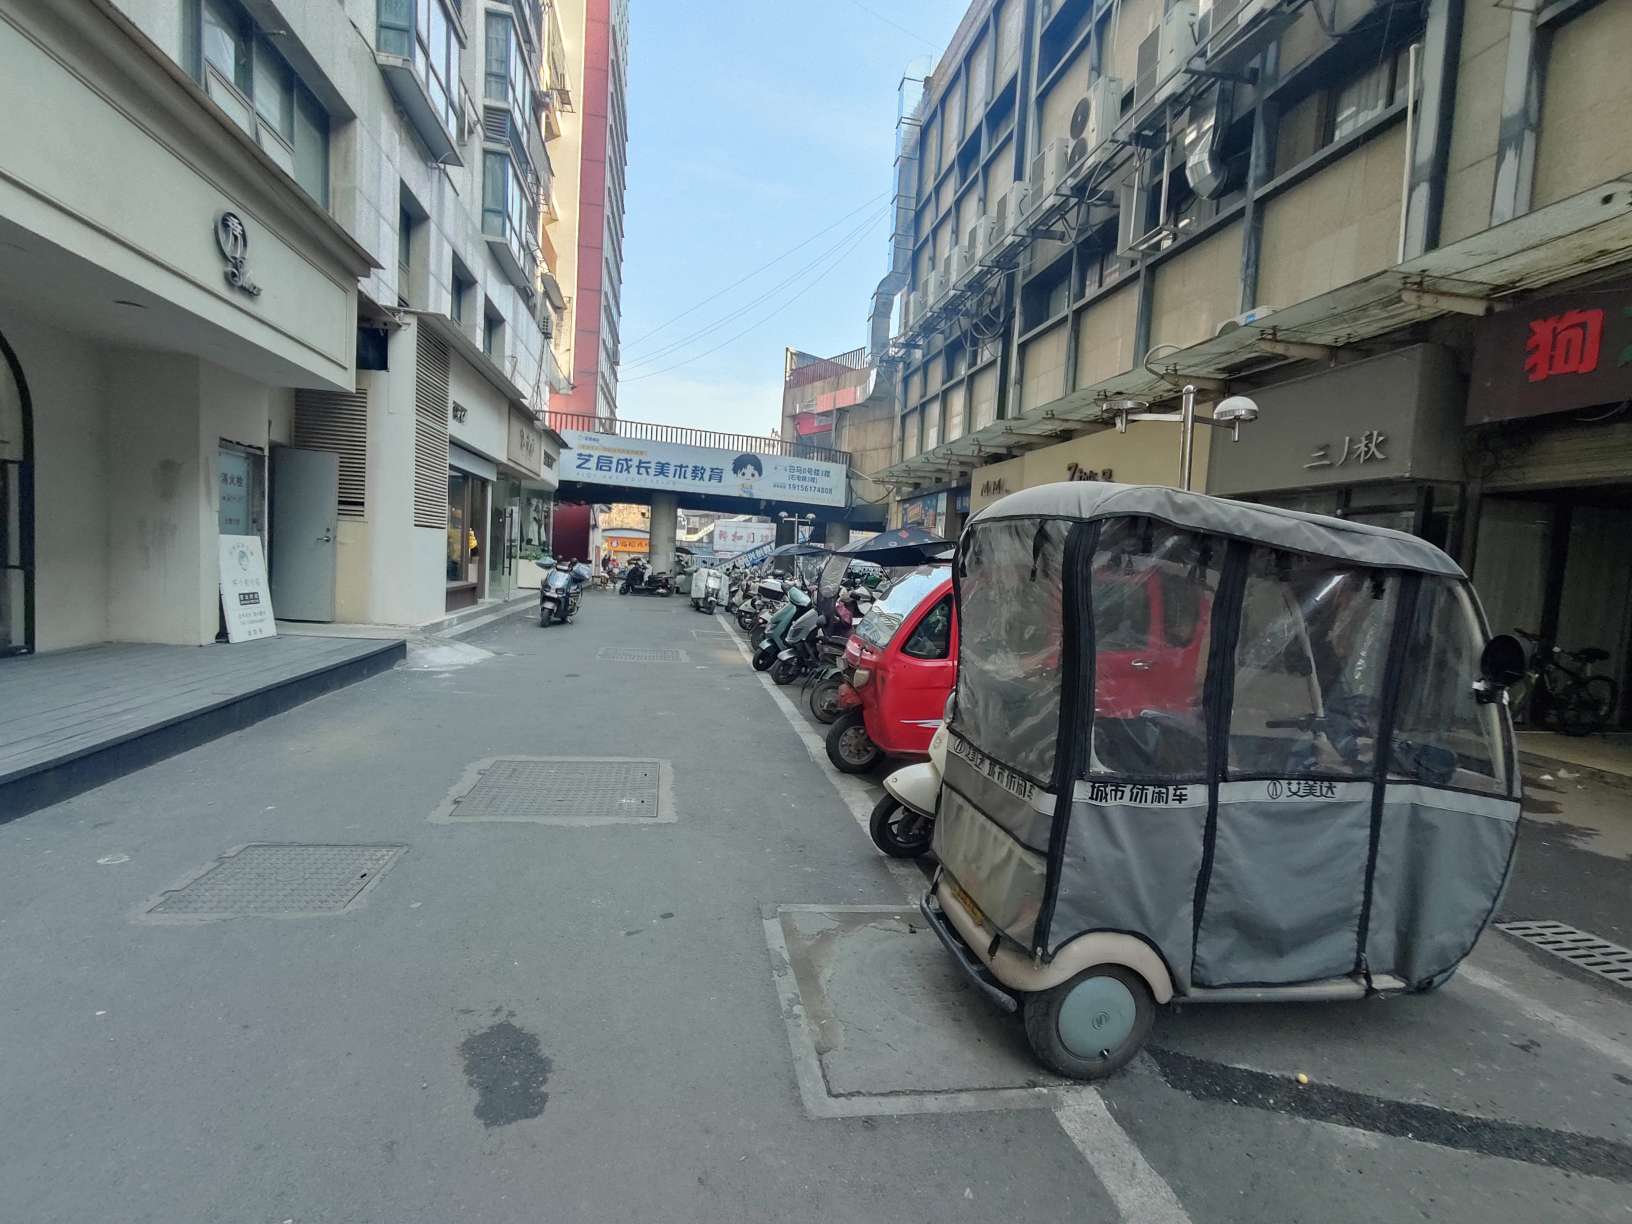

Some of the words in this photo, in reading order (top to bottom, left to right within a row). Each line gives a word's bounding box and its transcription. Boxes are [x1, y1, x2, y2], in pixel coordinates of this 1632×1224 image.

[1524, 309, 1605, 383] 狗
[575, 452, 724, 484] 艺启成长美术教育
[1088, 782, 1188, 804] 城市休闲车
